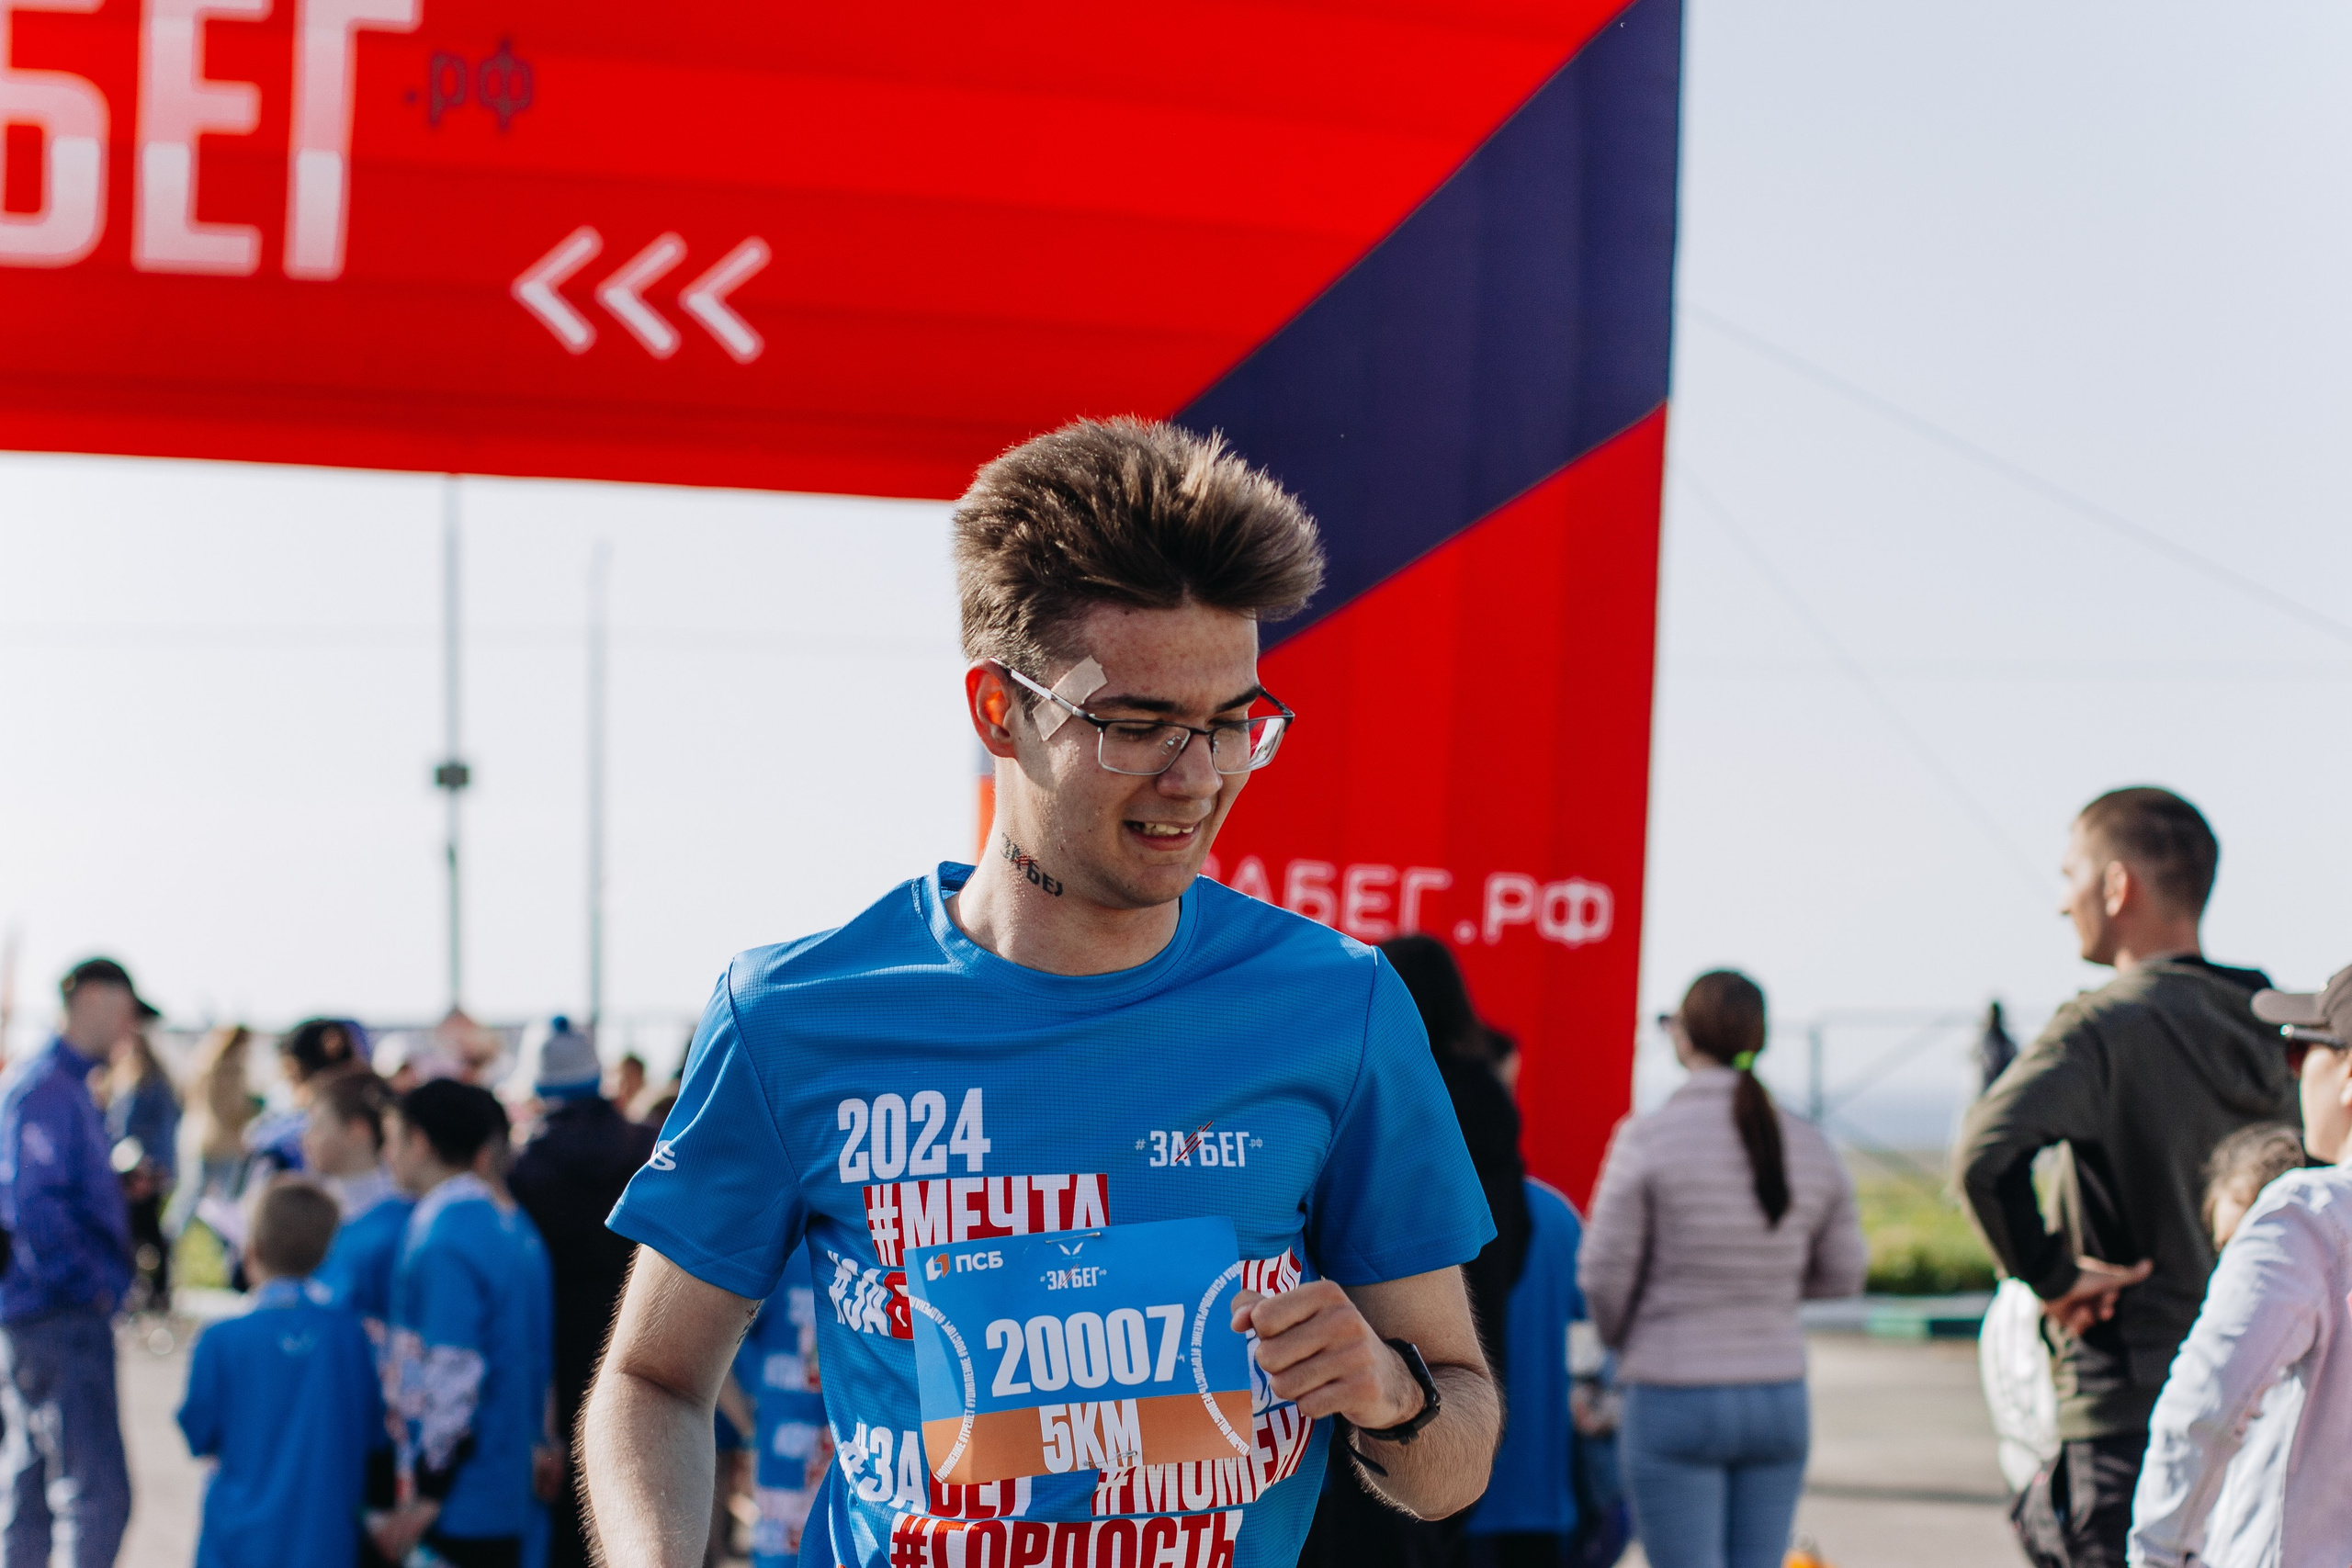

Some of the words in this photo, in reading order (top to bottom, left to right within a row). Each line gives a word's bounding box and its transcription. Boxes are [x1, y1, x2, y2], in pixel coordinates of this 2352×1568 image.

[1200, 854, 1613, 948] АБЕГ.РФ
[837, 1088, 991, 1183] 2024
[868, 1175, 1107, 1267] #МЕЧТА
[956, 1250, 1003, 1273] ПСБ
[985, 1303, 1185, 1397] 20007
